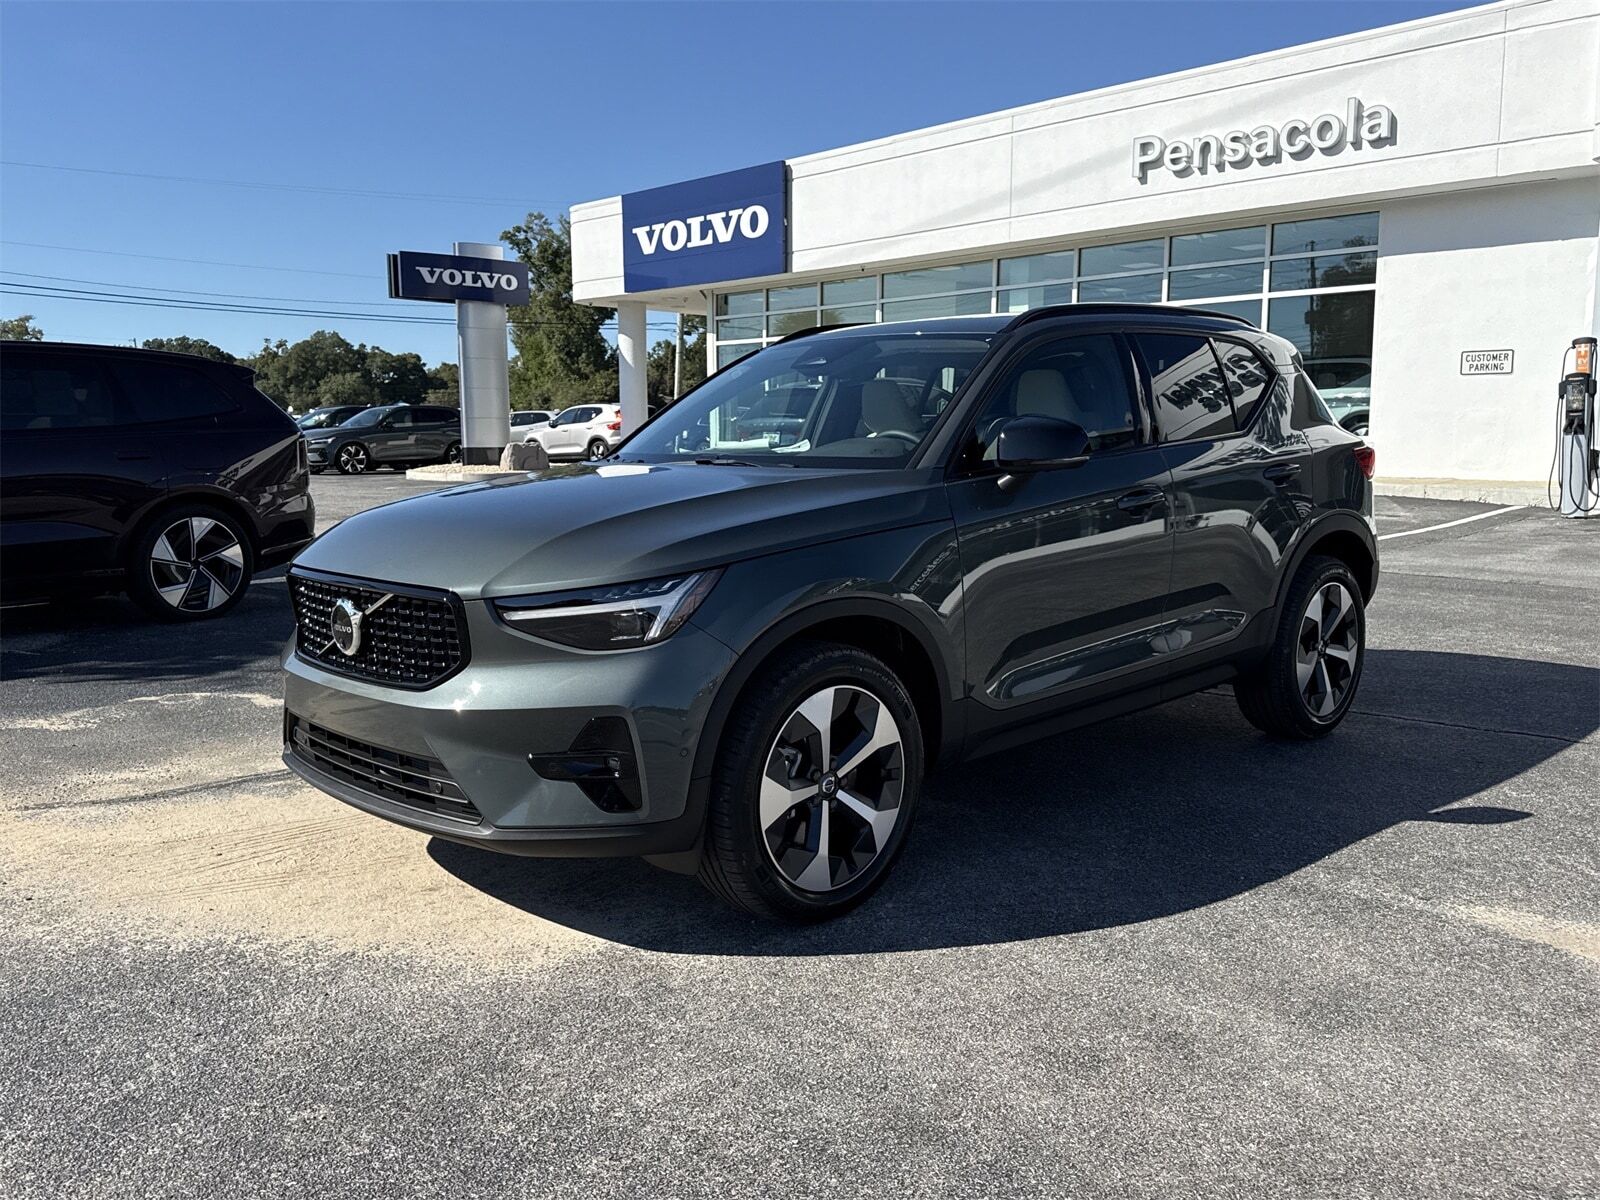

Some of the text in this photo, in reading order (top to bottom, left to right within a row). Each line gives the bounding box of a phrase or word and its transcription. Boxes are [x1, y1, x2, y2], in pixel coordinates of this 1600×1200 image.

[1132, 97, 1396, 184] Pensacola
[632, 204, 770, 256] VOLVO
[415, 266, 519, 291] VOLVO
[1465, 352, 1510, 363] CUSTOMER
[1468, 362, 1505, 372] PARKING
